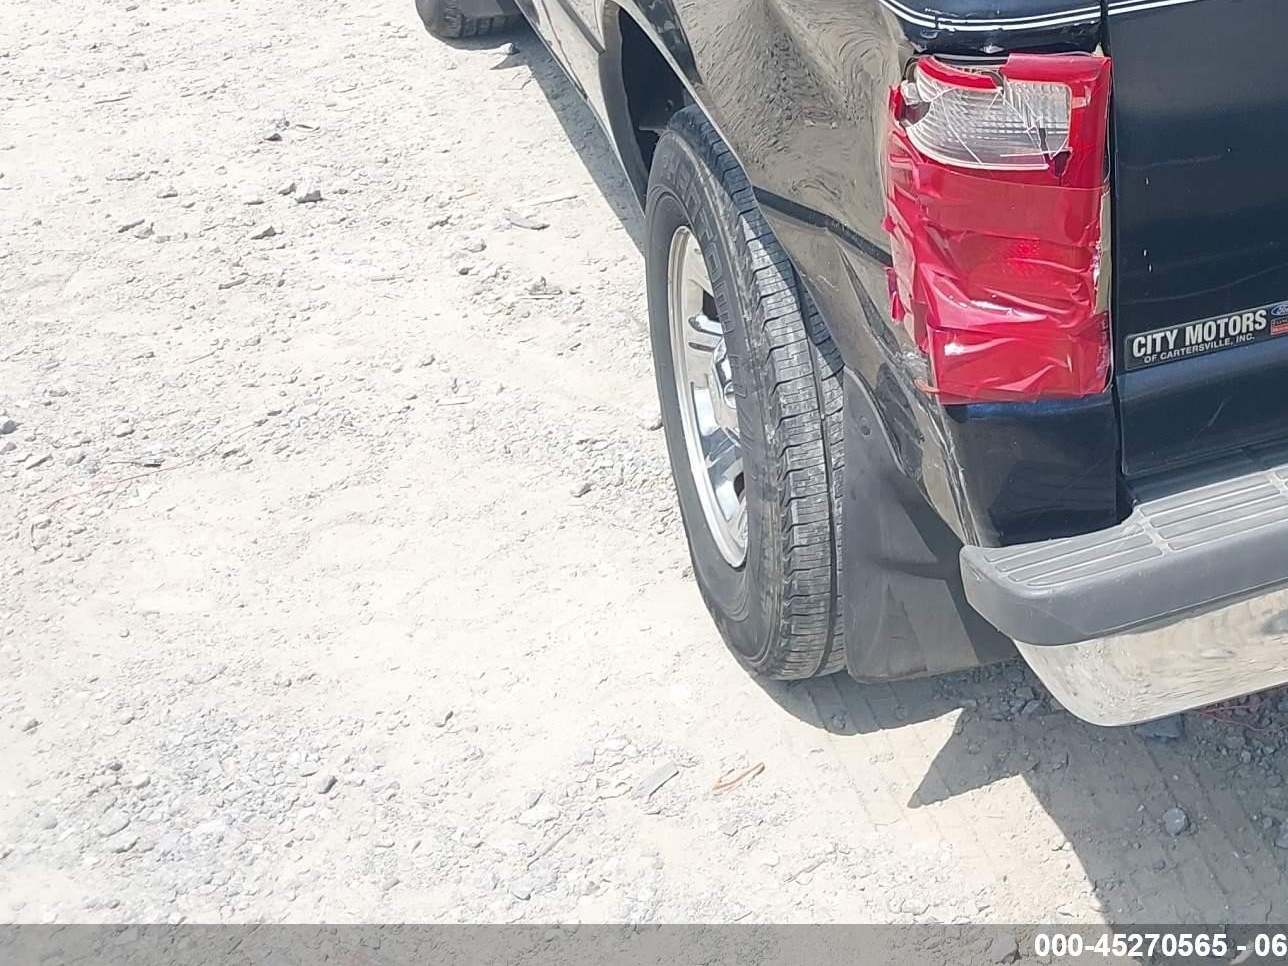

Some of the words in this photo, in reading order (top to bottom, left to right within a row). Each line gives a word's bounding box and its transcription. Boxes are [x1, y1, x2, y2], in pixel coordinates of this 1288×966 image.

[1132, 329, 1178, 357] CITY
[1185, 310, 1267, 347] MOTORS
[1144, 355, 1157, 364] OF
[1160, 339, 1233, 361] CARTERSVILLE,
[1236, 333, 1256, 343] INC.
